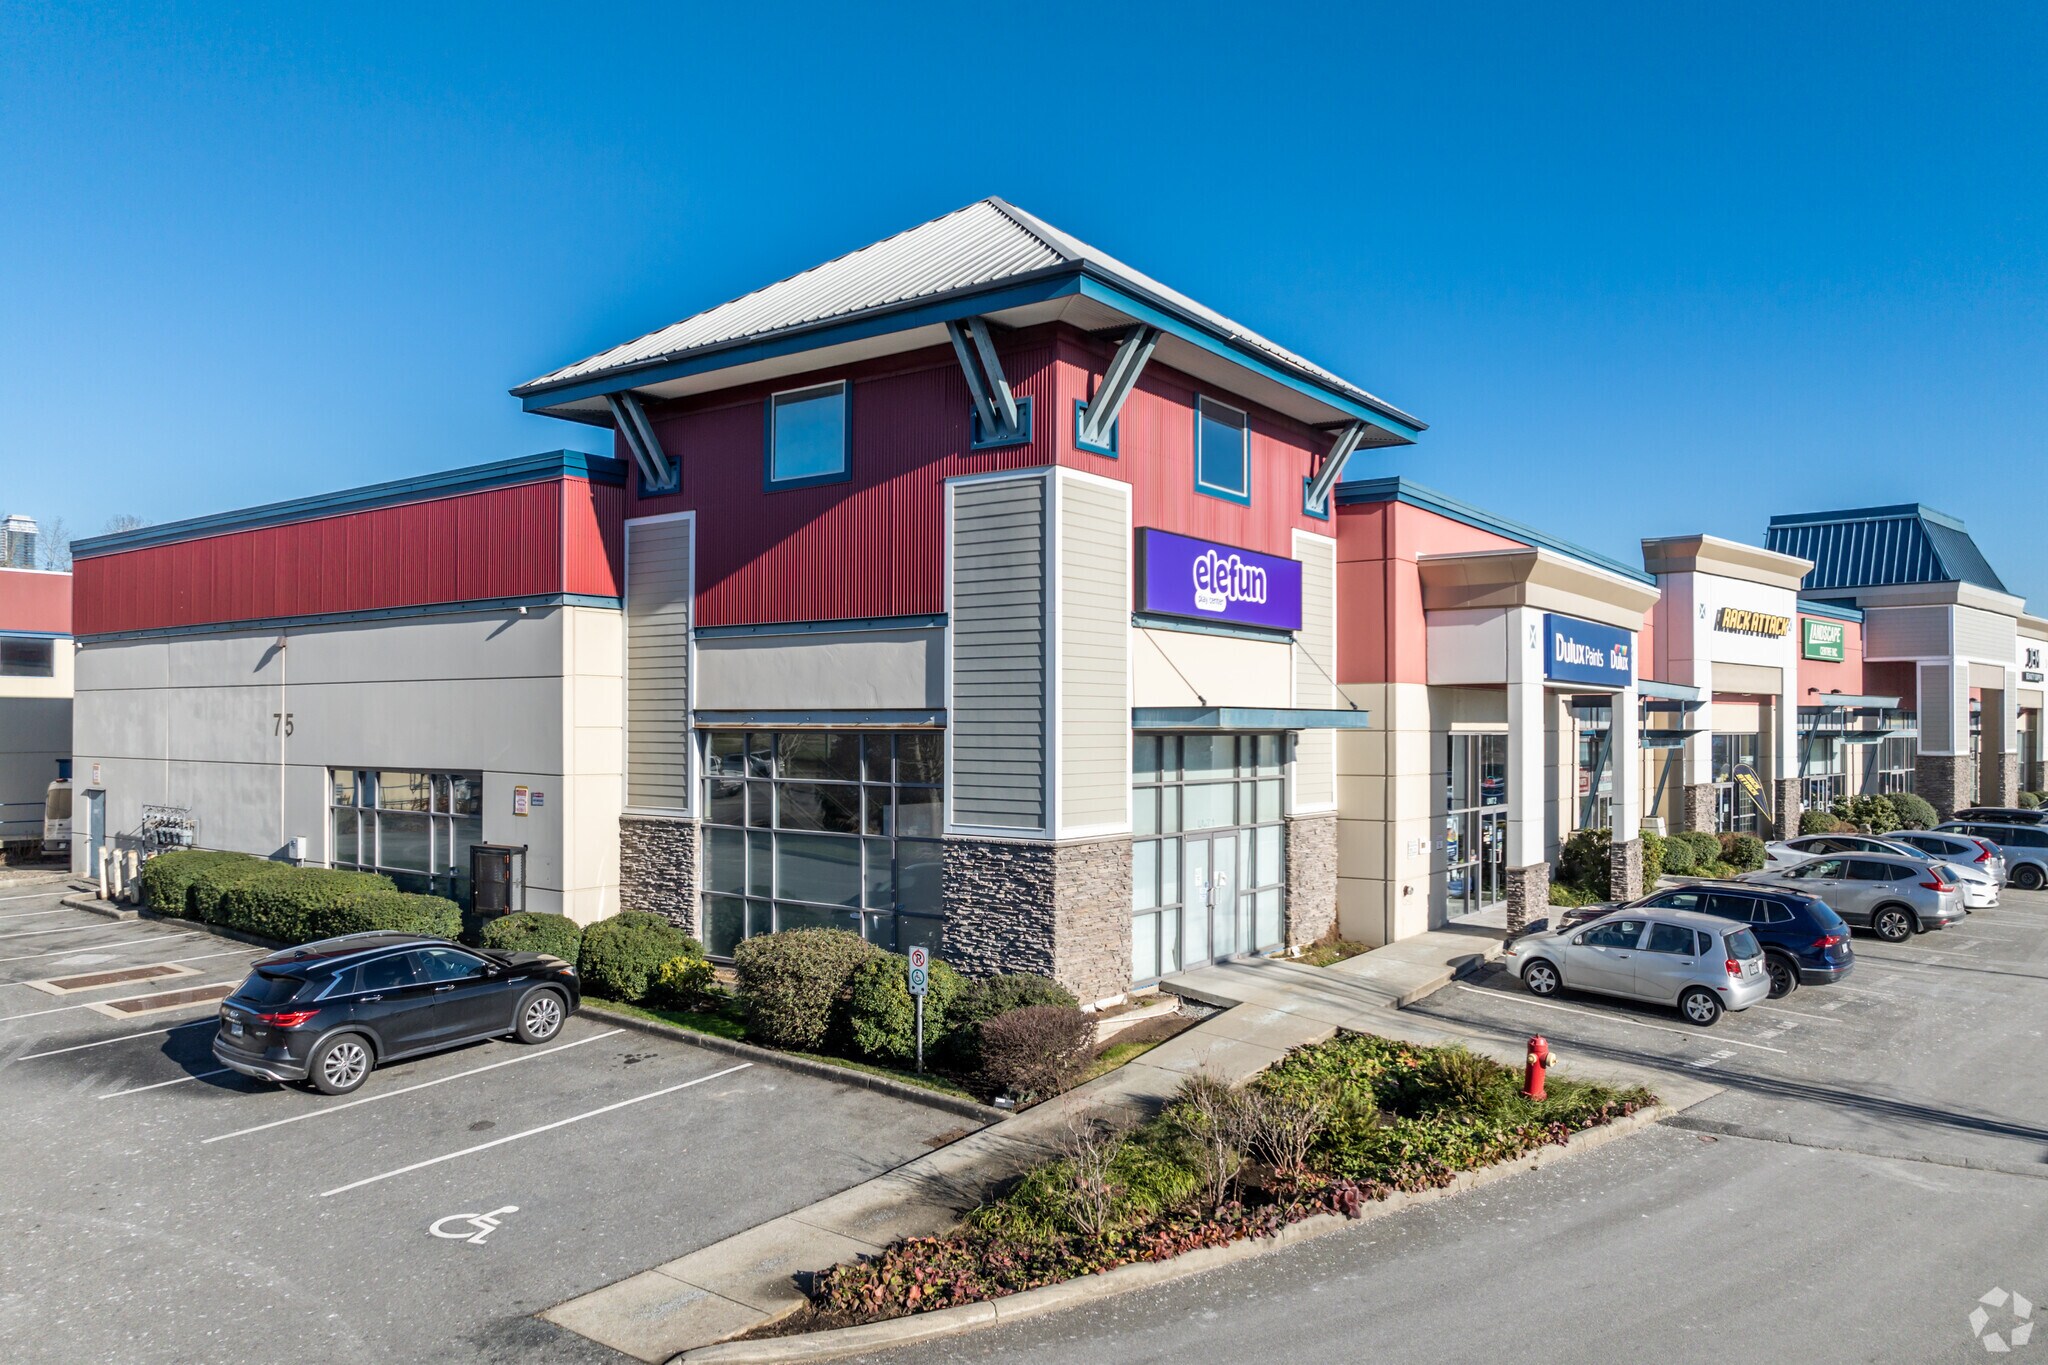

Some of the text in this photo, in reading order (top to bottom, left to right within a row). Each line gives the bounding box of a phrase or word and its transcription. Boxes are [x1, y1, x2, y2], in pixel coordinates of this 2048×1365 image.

[1194, 550, 1266, 603] elefun
[1722, 607, 1790, 636] RACK ATTACK
[1555, 632, 1604, 668] Dulux Paints
[1610, 649, 1629, 671] Dulux
[273, 713, 294, 737] 75
